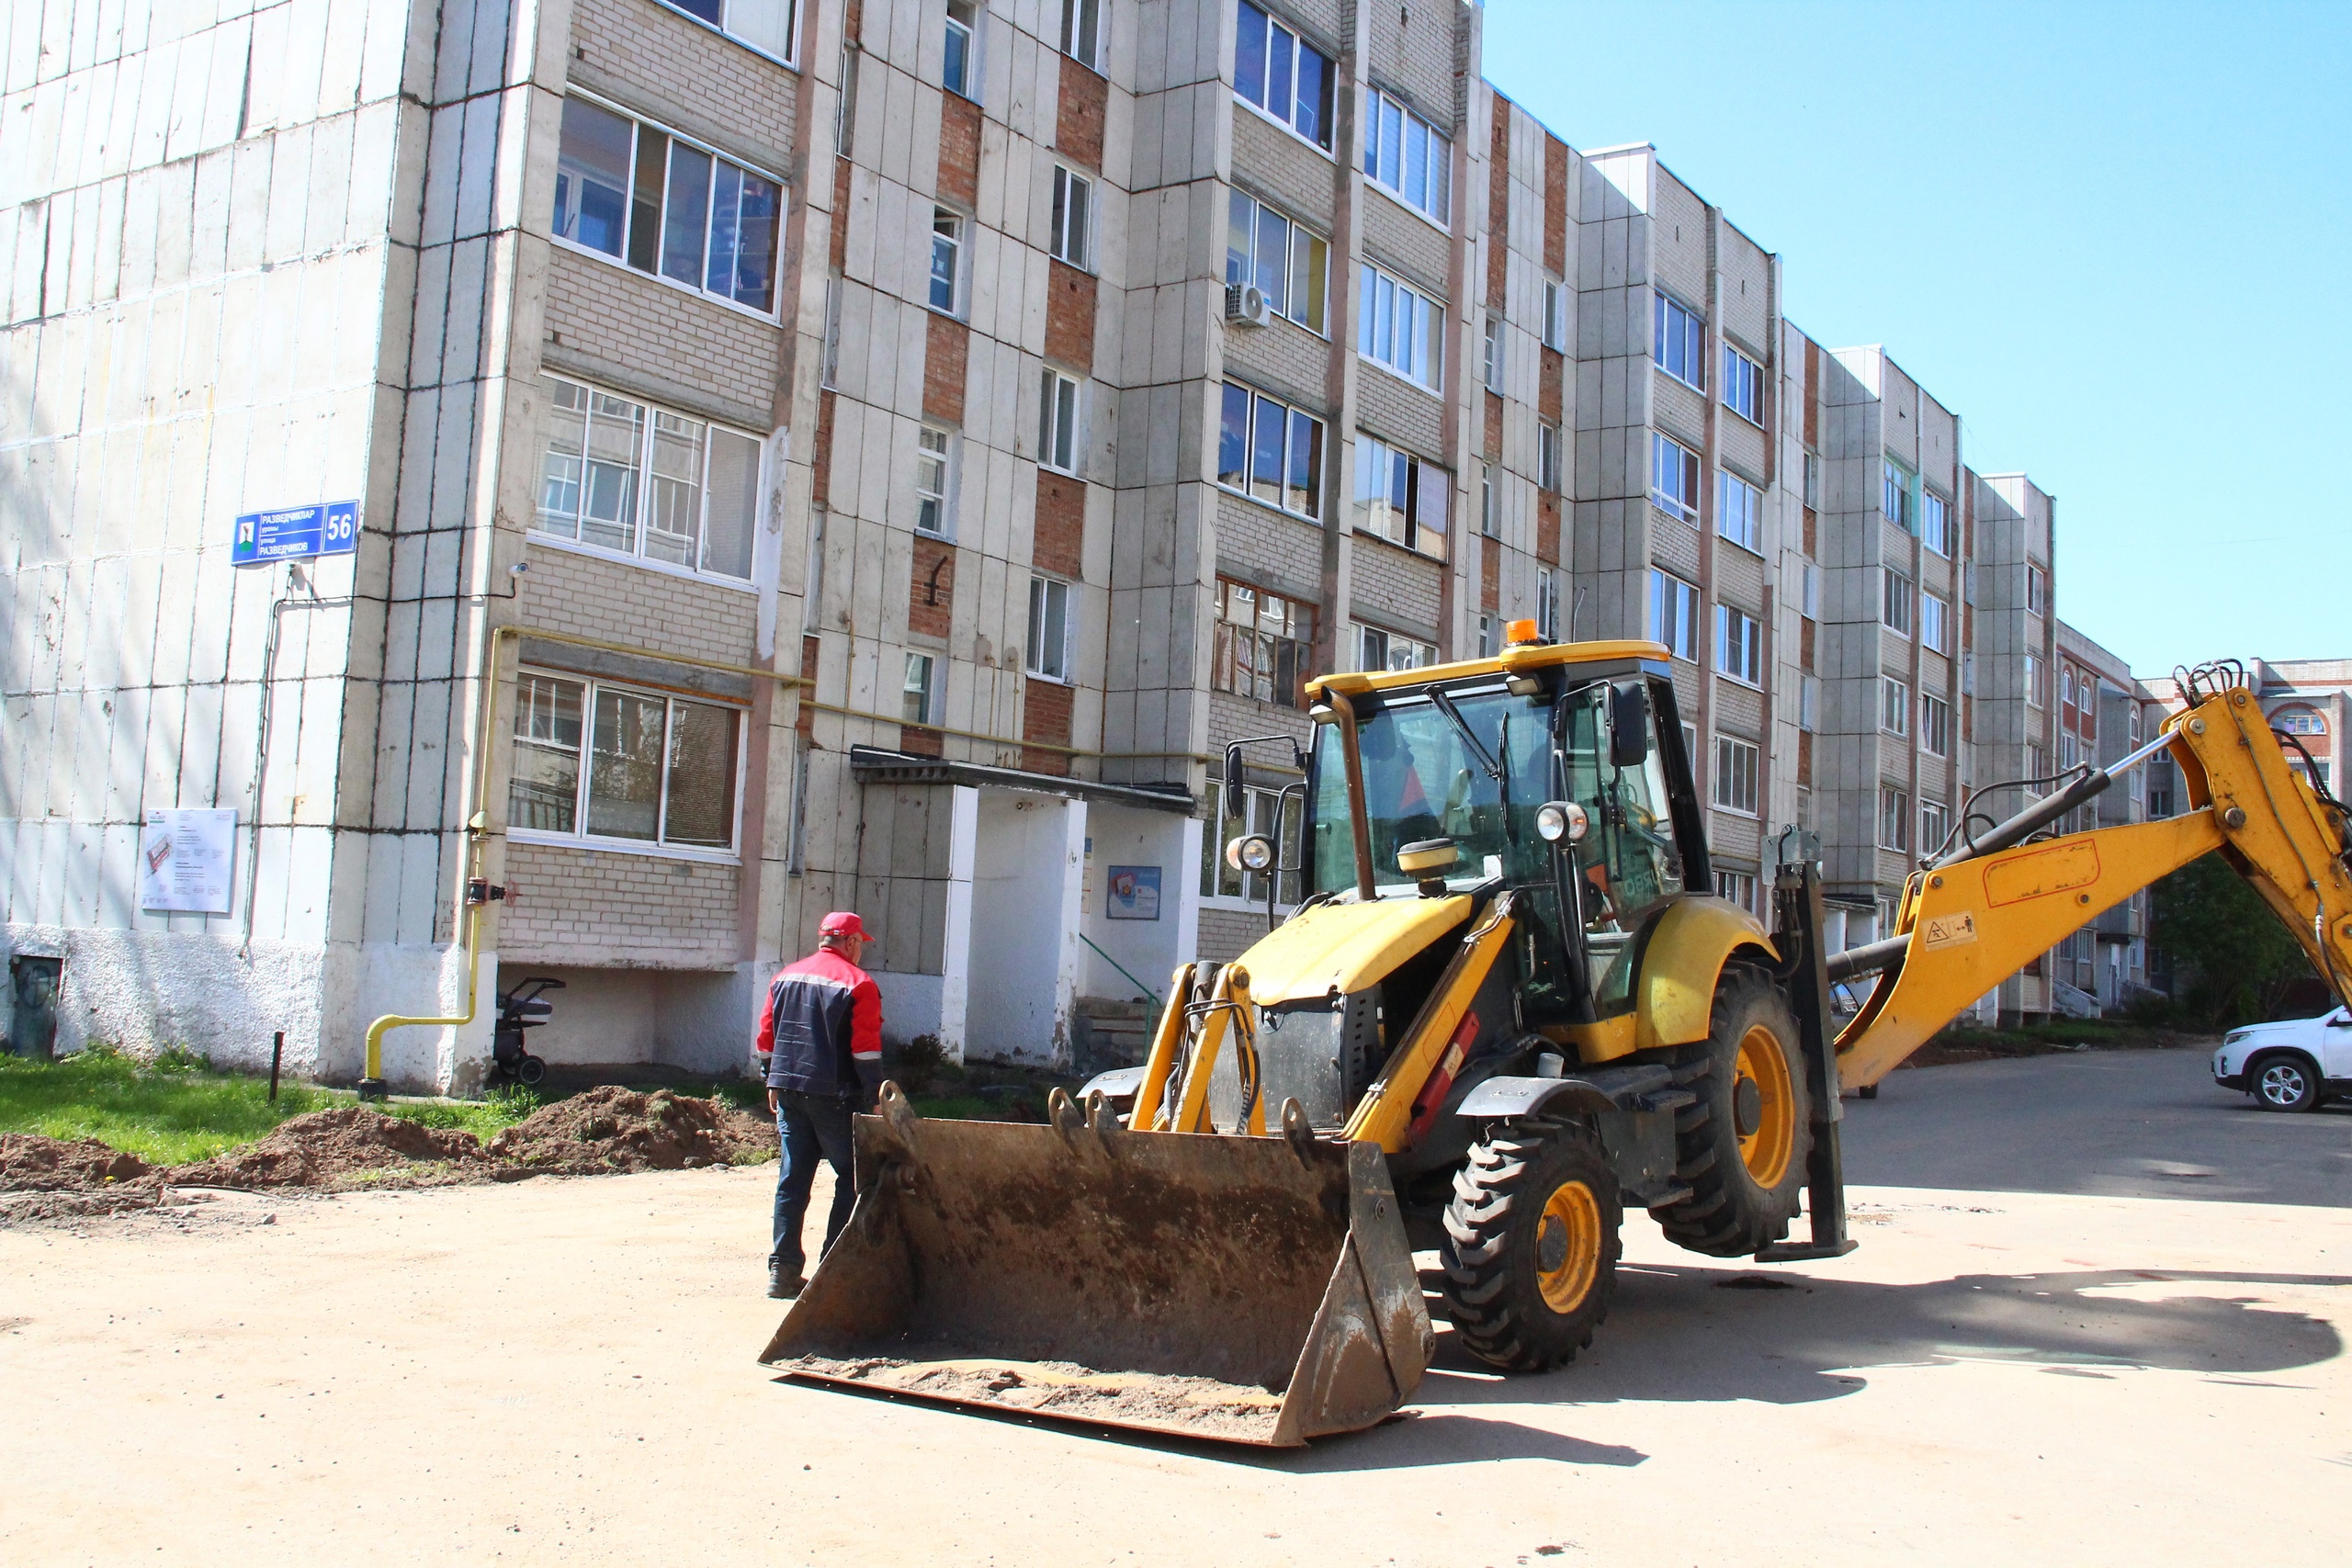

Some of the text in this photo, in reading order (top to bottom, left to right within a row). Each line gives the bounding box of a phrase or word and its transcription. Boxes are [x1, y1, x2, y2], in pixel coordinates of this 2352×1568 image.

[262, 510, 315, 525] РАЗВЕДЧИКЛАР
[327, 513, 352, 541] 56
[259, 542, 308, 556] РАЗВЕДЧИКОВ
